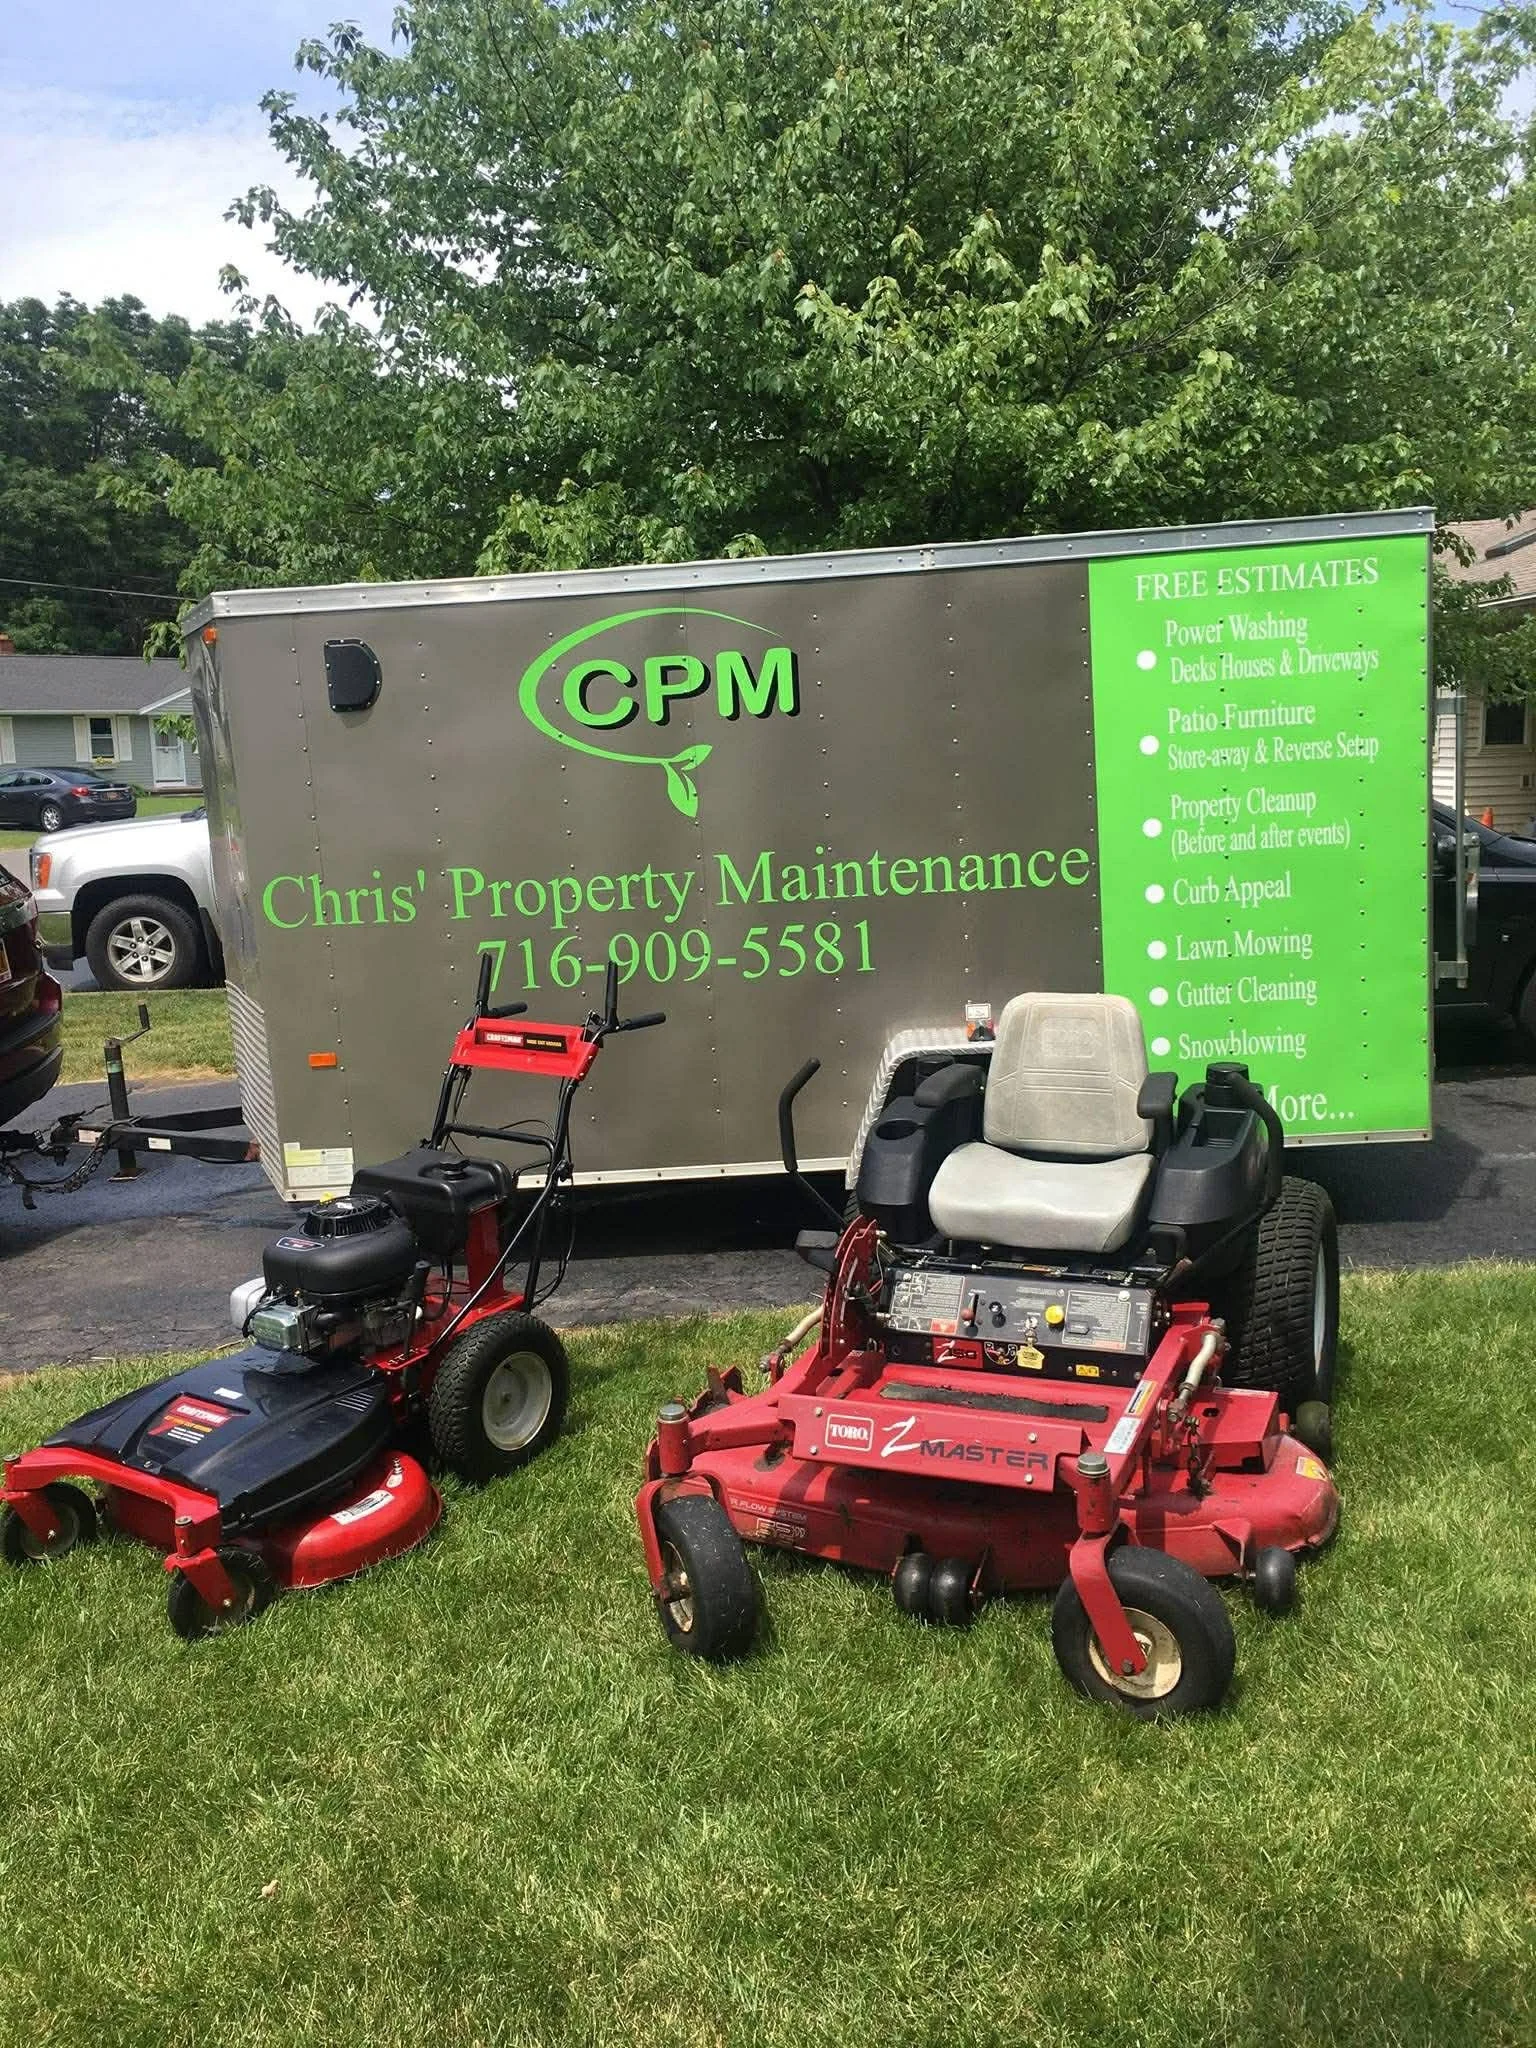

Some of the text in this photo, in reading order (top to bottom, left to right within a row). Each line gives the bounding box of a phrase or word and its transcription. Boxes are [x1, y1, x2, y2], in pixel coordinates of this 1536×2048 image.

[1135, 558, 1379, 600] FREE ESTIMATES
[1167, 611, 1307, 646] Power Washing
[1172, 647, 1377, 682] Decks Houses & Driveways
[562, 646, 799, 728] CPM
[1169, 700, 1315, 733] Patio Furniture
[1168, 732, 1378, 771] Store-away & Reverse Setup
[1172, 788, 1316, 825] Property Cleanup
[1171, 817, 1351, 858] (Before and after events)
[262, 846, 1090, 929] Chris' Property Maintenance
[1173, 871, 1290, 908] Curb Appeal
[477, 919, 876, 991] 716-909-5581
[1176, 927, 1313, 960] Lawn Mowing
[1177, 973, 1318, 1007] Gutter Cleaning
[1179, 1027, 1306, 1059] Snowblowing
[829, 1423, 868, 1440] TORO
[920, 1440, 1049, 1471] MASTER
